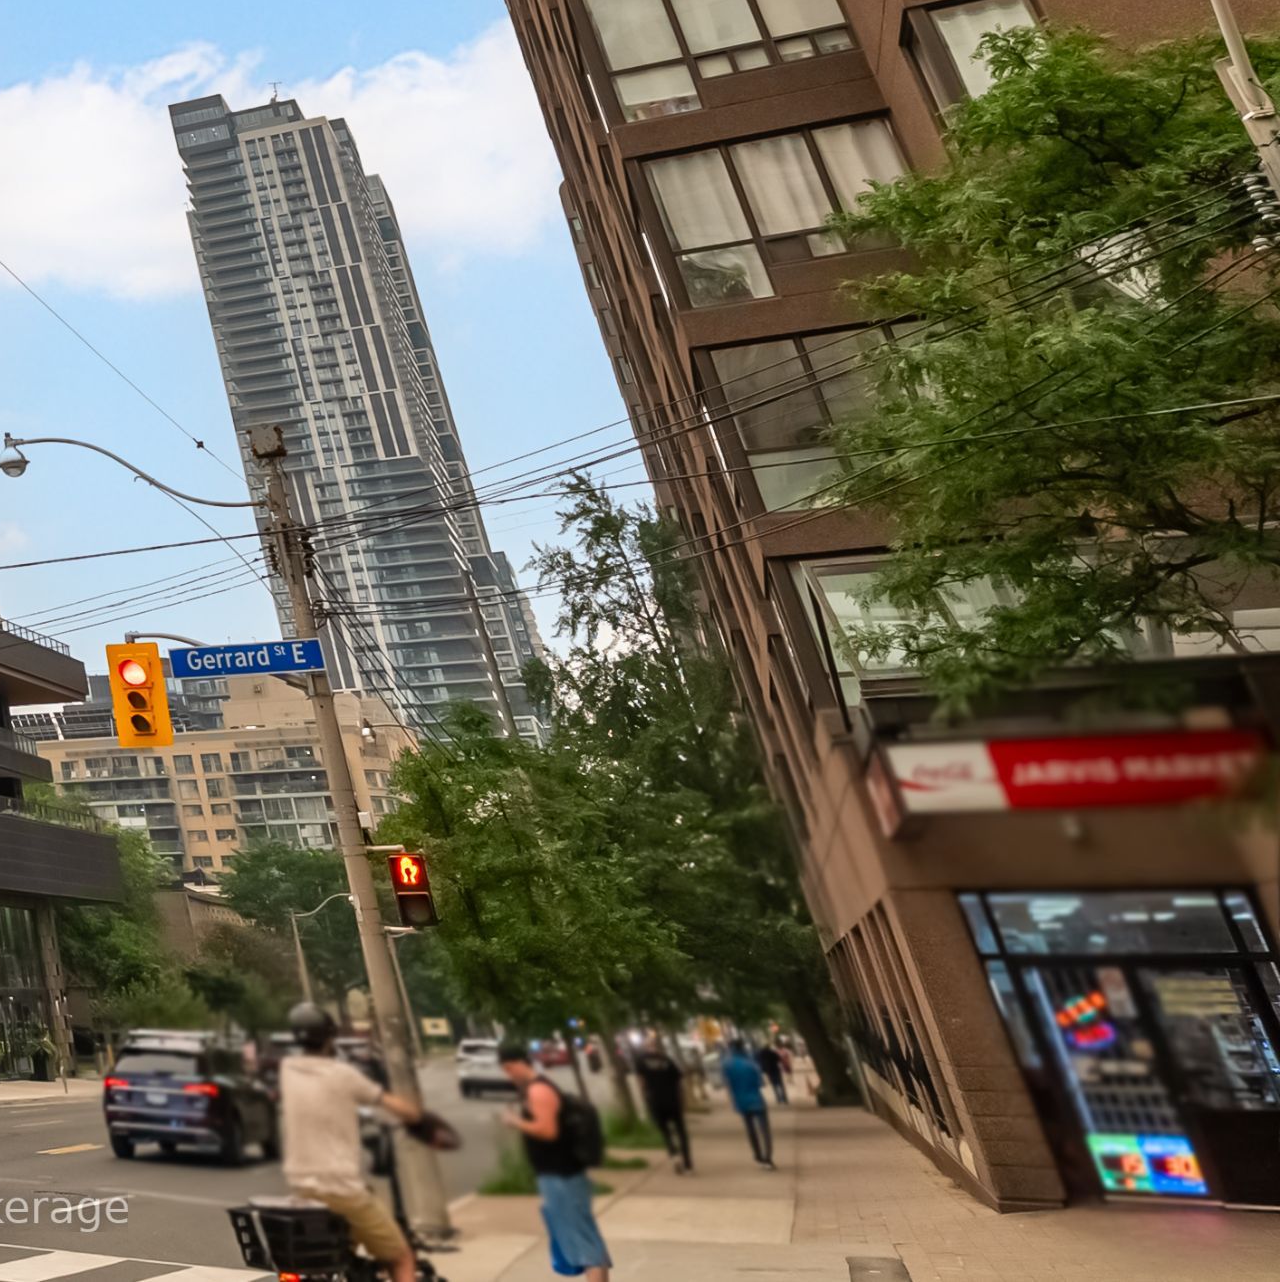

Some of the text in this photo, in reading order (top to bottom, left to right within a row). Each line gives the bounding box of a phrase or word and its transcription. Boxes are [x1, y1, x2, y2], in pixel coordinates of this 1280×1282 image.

[187, 643, 306, 670] Gerrard St E
